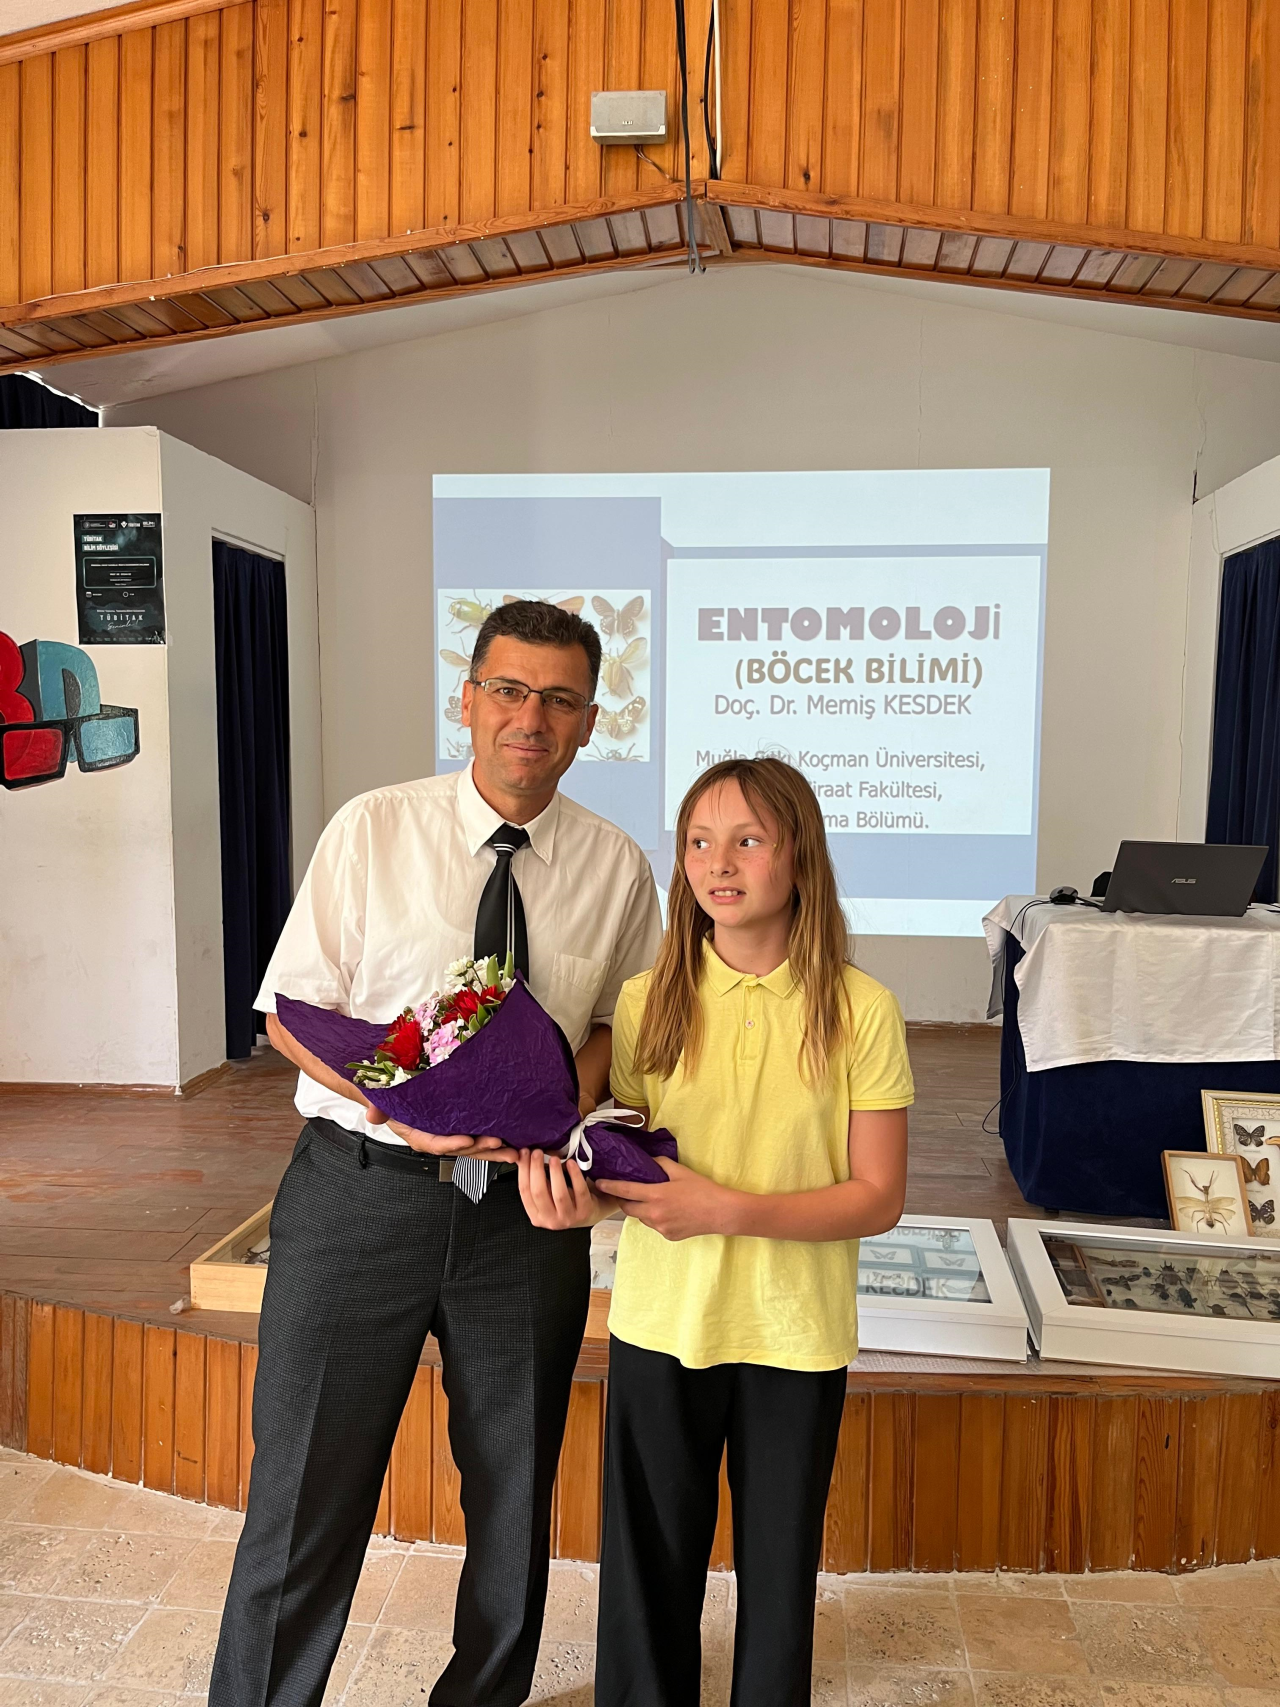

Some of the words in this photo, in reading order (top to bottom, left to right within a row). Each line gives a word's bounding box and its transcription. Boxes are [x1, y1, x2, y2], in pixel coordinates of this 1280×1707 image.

[99, 613, 144, 621] TÜBİTAK
[735, 650, 854, 689] (BÖCEK
[865, 652, 983, 689] BİLİMİ)
[714, 694, 760, 719] Doç.
[770, 694, 798, 716] Dr.
[807, 694, 875, 719] Memiş
[884, 694, 972, 715] KESDEK
[799, 750, 869, 771] Koçman
[876, 747, 986, 772] Üniversitesi,
[808, 780, 853, 798] iraat
[859, 780, 942, 802] Fakültesi,
[856, 811, 929, 829] Bölümü.
